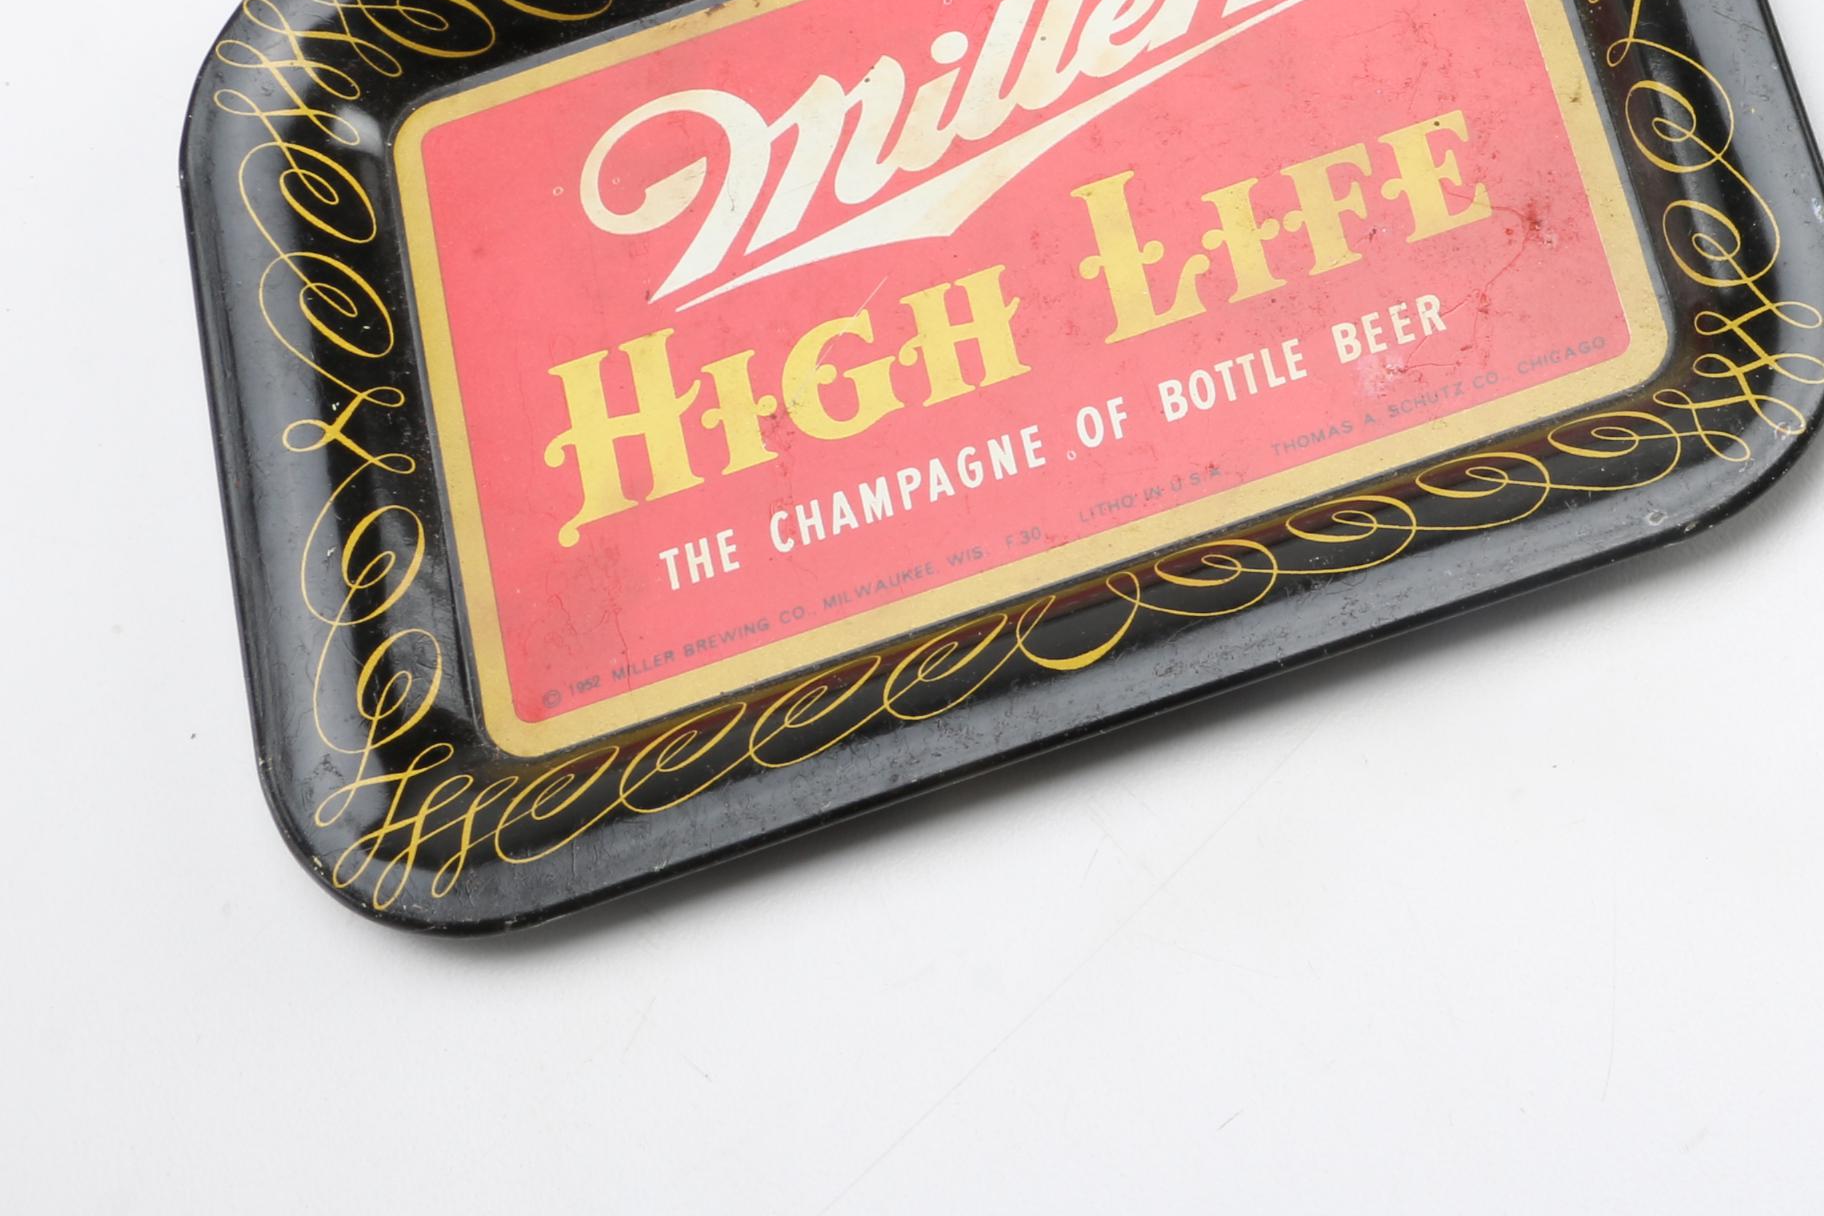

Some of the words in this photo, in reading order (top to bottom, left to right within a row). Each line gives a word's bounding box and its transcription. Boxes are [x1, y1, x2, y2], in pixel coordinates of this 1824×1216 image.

[543, 263, 1034, 546] HIGH
[1070, 110, 1492, 343] LIFE
[659, 530, 739, 589] THE
[769, 422, 1047, 553] CHAMPAGNE
[1076, 397, 1128, 448] OF
[1158, 339, 1308, 424] BOTTLE
[1331, 294, 1446, 362] BEER
[610, 649, 676, 682] MILLER
[681, 617, 770, 658] BREWING
[1142, 484, 1162, 502] IN
[1270, 417, 1354, 458] THOMAS
[1387, 381, 1464, 419] SCHUTZ
[1515, 332, 1606, 376] CHICAGO
